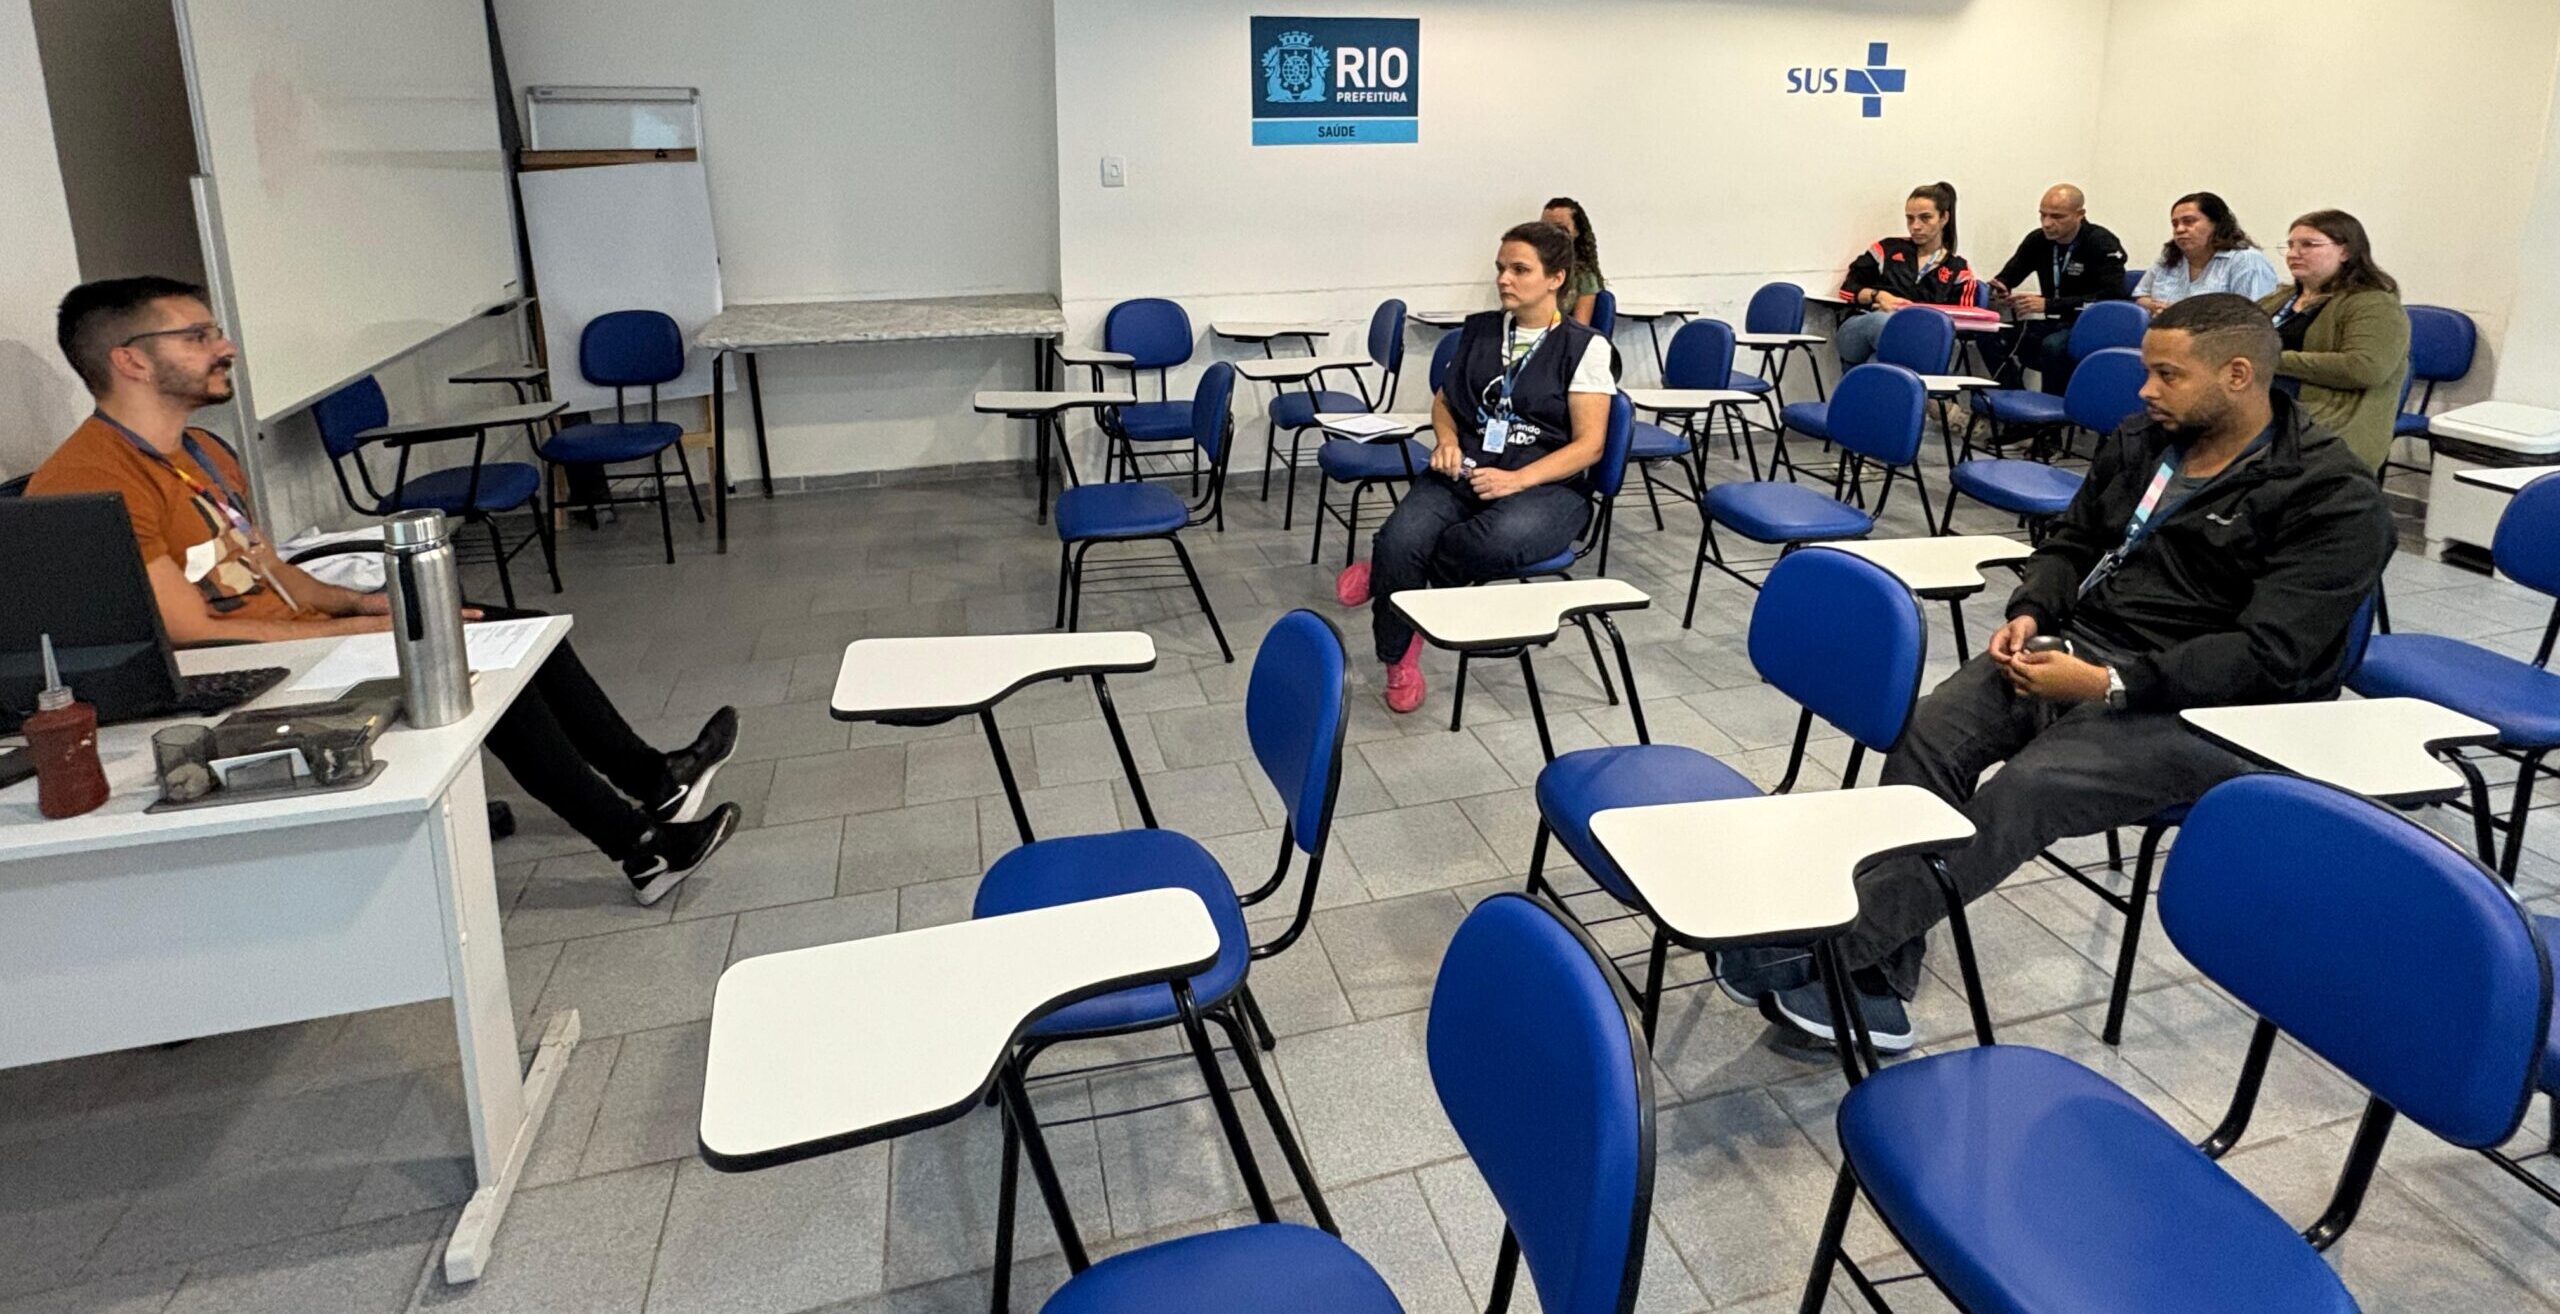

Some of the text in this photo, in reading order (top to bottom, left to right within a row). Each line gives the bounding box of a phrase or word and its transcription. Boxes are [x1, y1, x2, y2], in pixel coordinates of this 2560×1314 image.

[1336, 47, 1409, 88] RIO
[1786, 67, 1838, 94] SUS
[1336, 91, 1408, 103] PREFEITURA
[1317, 123, 1356, 138] SAÚDE
